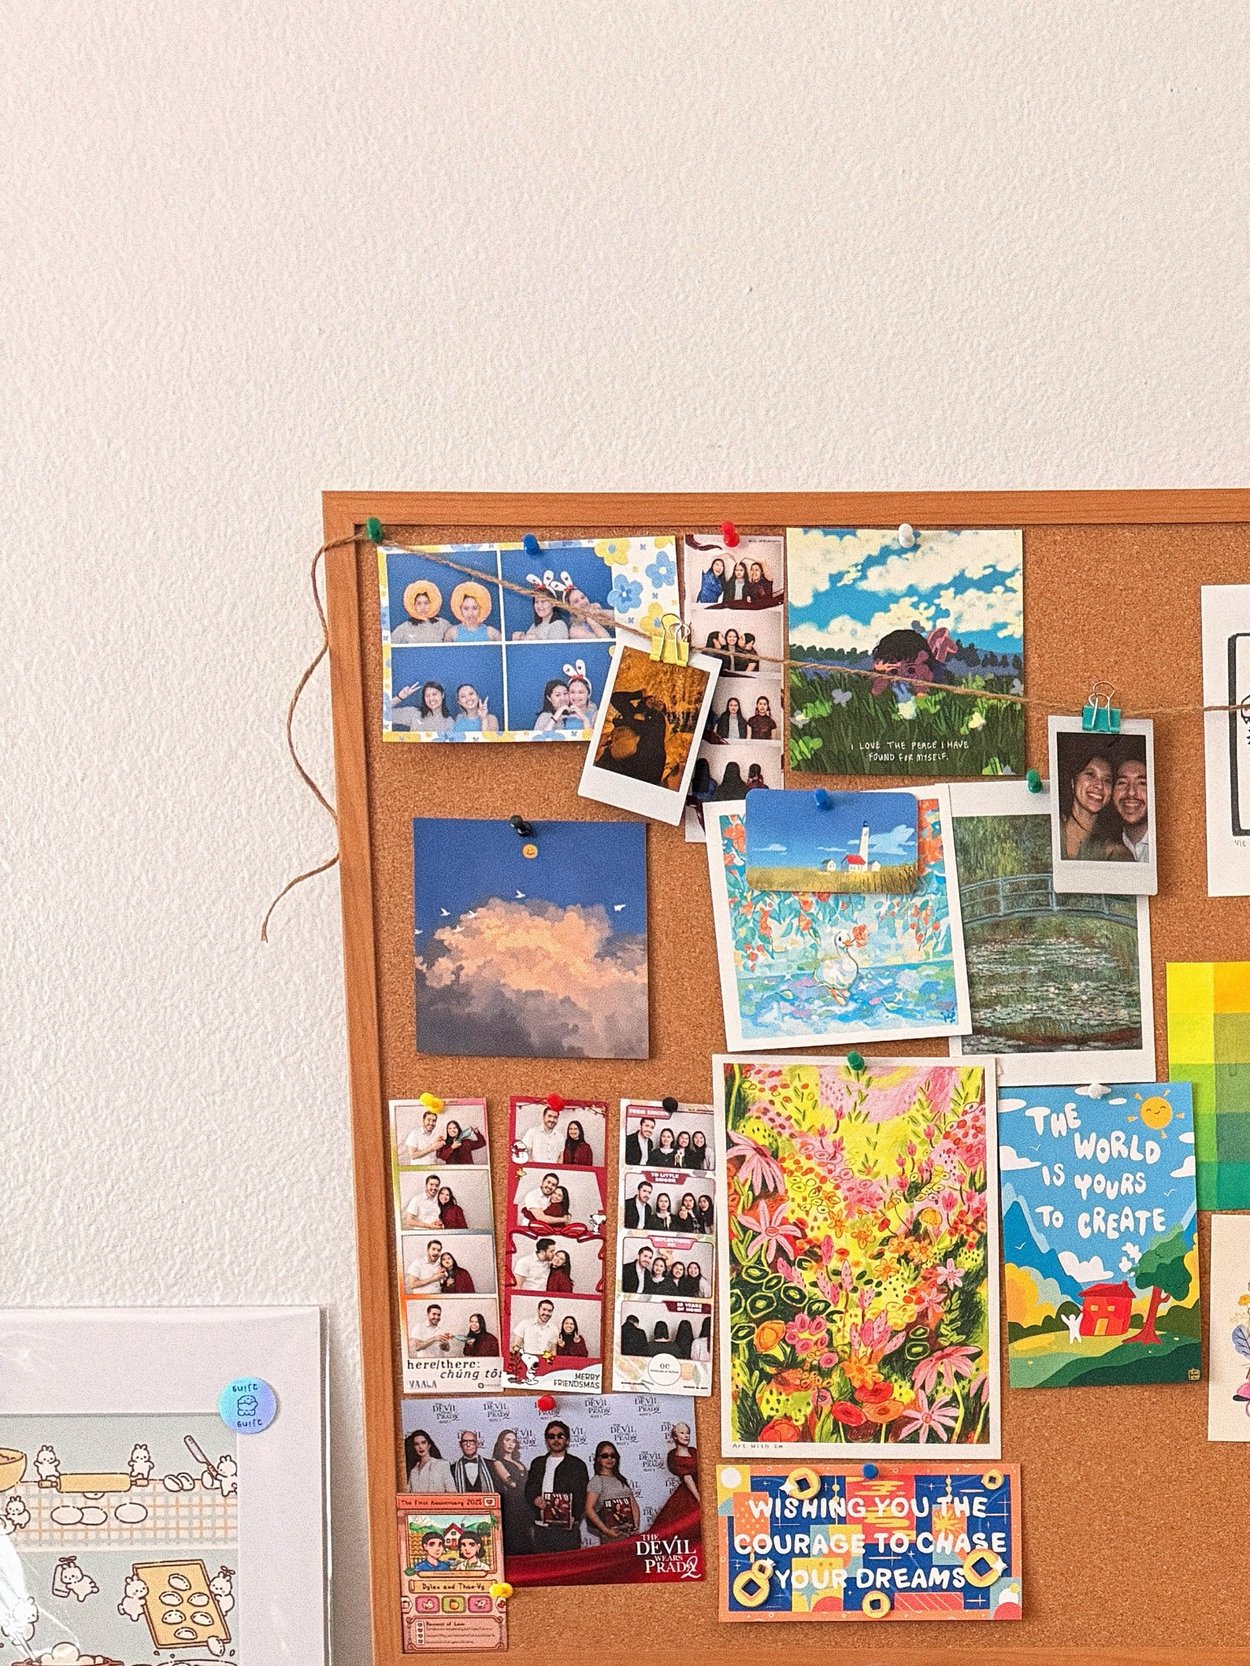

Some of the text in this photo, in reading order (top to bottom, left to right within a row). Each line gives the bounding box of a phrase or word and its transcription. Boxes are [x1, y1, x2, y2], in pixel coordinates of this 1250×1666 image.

[859, 741, 880, 750] LOVE
[886, 741, 906, 750] THE
[911, 740, 938, 751] PEACE
[947, 741, 969, 749] HAVE
[868, 752, 895, 761] FOUND
[1025, 1102, 1081, 1137] THE
[1074, 1131, 1161, 1164] WORLD
[1042, 1163, 1147, 1200] IS YOURS
[1035, 1206, 1166, 1239] TO CREATE
[440, 1367, 480, 1381] chúng
[553, 1379, 600, 1390] FRIENDSMAS
[575, 1372, 600, 1380] MERRY
[750, 1496, 988, 1519] WISHING YOU THE
[636, 1535, 697, 1555] DEVIL
[734, 1532, 1007, 1555] COURAGE TO CHASE
[774, 1567, 966, 1590] YOUR DREAMS
